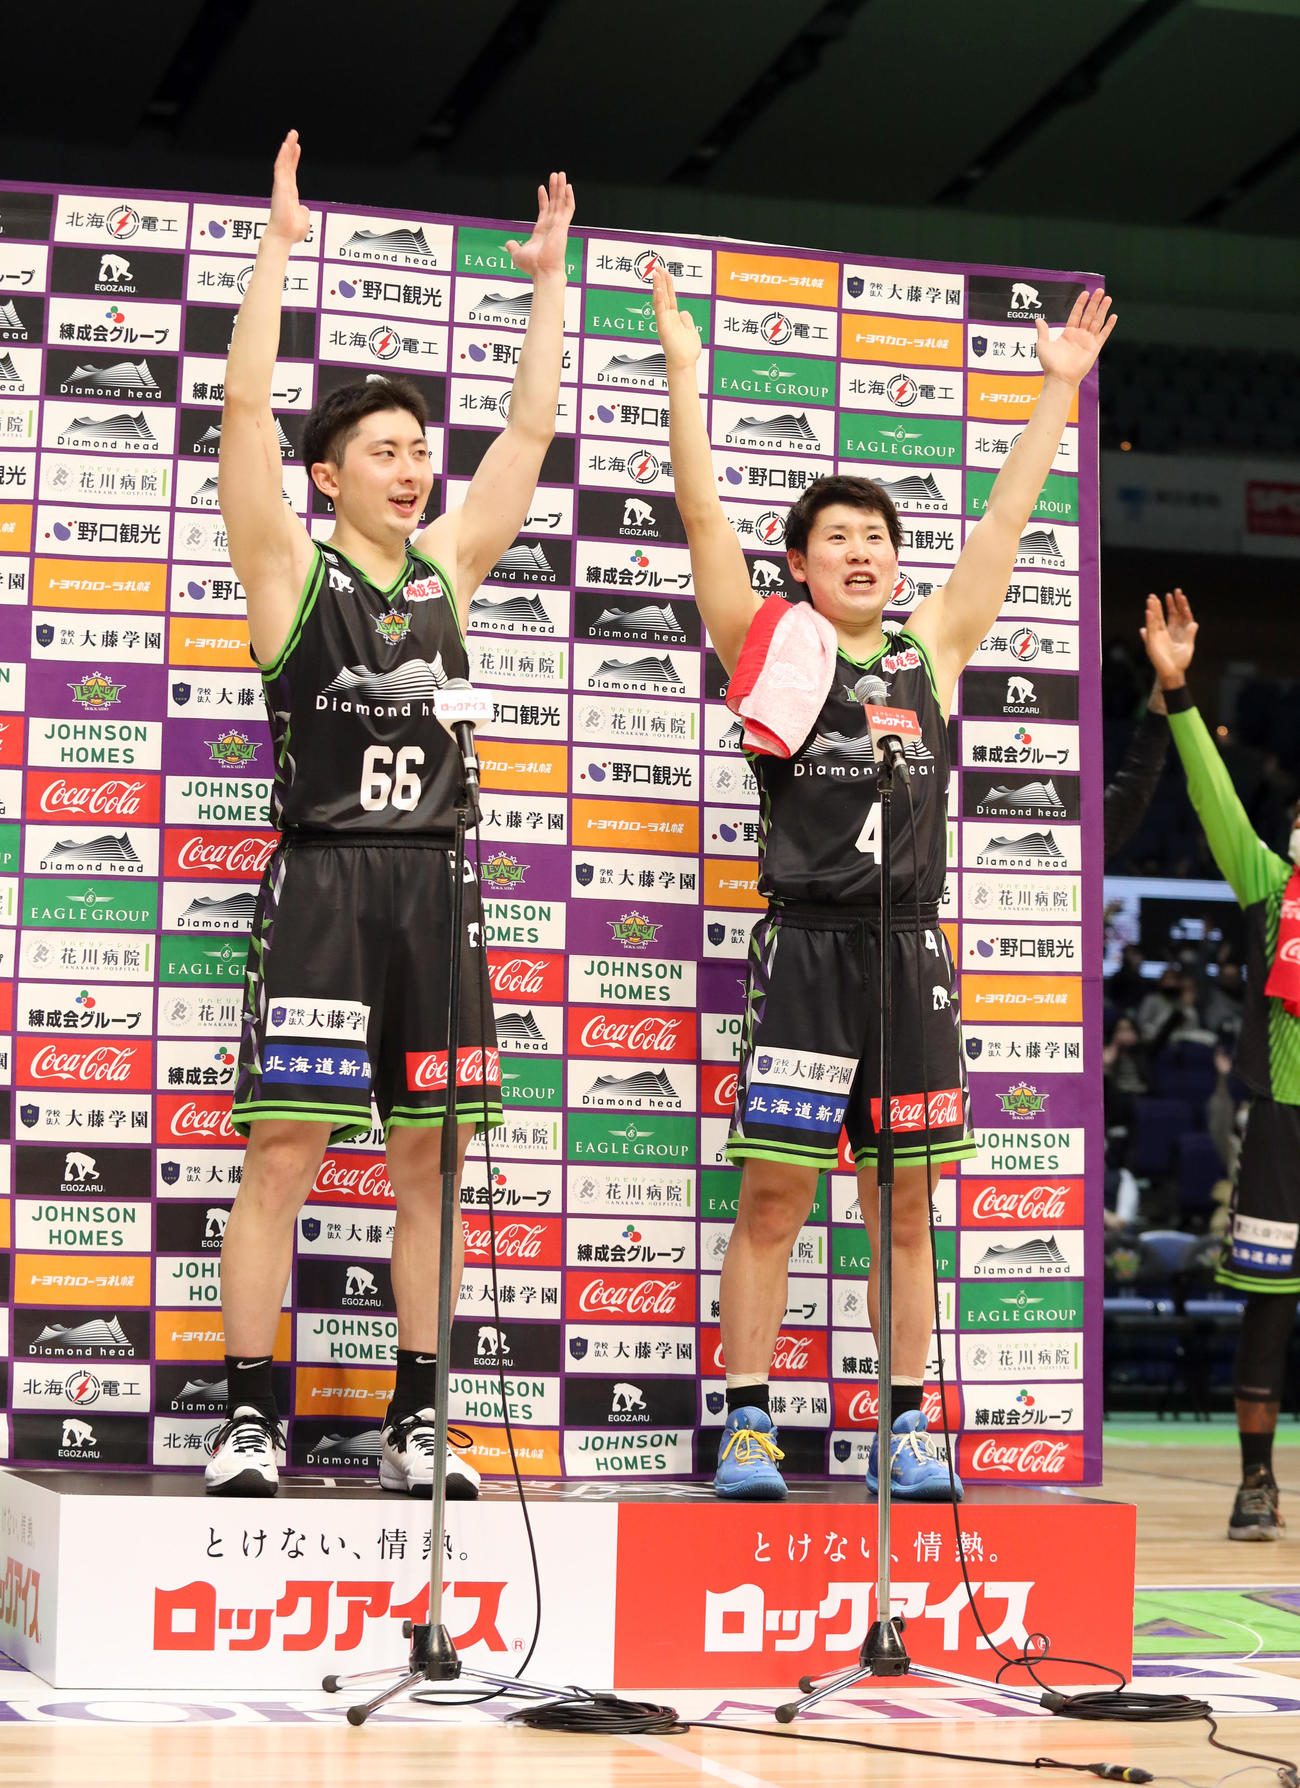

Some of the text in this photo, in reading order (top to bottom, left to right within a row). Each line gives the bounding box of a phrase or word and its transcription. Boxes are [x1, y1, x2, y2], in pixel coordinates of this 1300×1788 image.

[339, 248, 438, 268] Diamond head
[94, 284, 136, 294] EGOZARU
[730, 272, 825, 289] トヨタカローラ札幌
[362, 281, 443, 308] 野口観光
[887, 284, 961, 306] 大藤学園
[592, 316, 646, 332] EAGLE
[1007, 311, 1046, 320] EGOZARU
[59, 323, 169, 345] 練成会グループ
[856, 332, 949, 350] トヨタカローラ札幌
[60, 383, 162, 399] Diamond head
[721, 377, 829, 399] EAGLE GROUP
[57, 436, 159, 451] Diamond head
[725, 434, 821, 452] Diamond head
[847, 439, 900, 456] EAGLE
[902, 444, 956, 458] GROUP
[80, 472, 157, 491] 花川病院
[748, 467, 825, 490] 野口観光
[77, 520, 161, 545] 野口観光
[619, 527, 660, 538] EGOZARU
[48, 578, 151, 594] トヨタカローラ札幌
[585, 566, 692, 590] 練成会グループ
[1003, 584, 1072, 607] 野口観光
[60, 629, 75, 638] 学校
[60, 637, 75, 646] 法人
[79, 629, 162, 650] 大藤学園
[589, 626, 687, 644] Diamond head
[480, 654, 555, 674] 花川病院
[588, 678, 686, 695] Diamond head
[315, 694, 422, 718] Diamond
[1002, 705, 1040, 714] EGOZARU
[44, 723, 148, 742] JOHNSON
[611, 713, 686, 734] 花川病院
[60, 747, 135, 764] HOMES
[972, 744, 1070, 766] 練成会グループ
[360, 744, 425, 812] 66
[611, 762, 692, 787] 野口観光
[793, 763, 879, 778] Diamon
[40, 779, 146, 816] Coca-Cola
[485, 810, 565, 831] 大藤学園
[977, 806, 1067, 818] Diamond head
[586, 818, 684, 834] トヨタカローラ札幌
[40, 860, 144, 874] Diamond head
[977, 855, 1068, 868] Diamond head
[599, 867, 614, 876] 学校
[599, 876, 614, 884] 法人
[618, 868, 696, 891] 大藤学園
[999, 889, 1068, 907] 花川病院
[31, 907, 150, 923] EAGLE GROUP
[999, 937, 1074, 958] 野口観光
[61, 948, 140, 966] 花川病院
[168, 962, 227, 976] EAGLE
[583, 960, 683, 980] JOHNSON
[600, 983, 671, 1002] HOMES
[975, 993, 1069, 1005] トヨタカローラ札幌
[28, 1009, 142, 1030] 練成会グループ
[306, 1009, 366, 1031] 大藤学
[581, 1015, 683, 1052] Coca-Cola
[988, 1042, 1001, 1050] 学校
[988, 1049, 1001, 1057] 法人
[1005, 1041, 1080, 1060] 大藤学園
[30, 1045, 137, 1081] Coca-Cola
[789, 1059, 853, 1085] 大藤学園
[500, 1085, 556, 1100] GROUP
[582, 1095, 682, 1109] Diamond head
[45, 1109, 61, 1118] 学校
[45, 1117, 61, 1126] 法人
[65, 1109, 149, 1130] 大藤学園
[576, 1140, 689, 1158] EAGLE GROUP
[976, 1133, 1071, 1149] JOHNSON
[991, 1154, 1060, 1171] HOMES
[60, 1183, 104, 1193] EGOZARU
[606, 1183, 682, 1201] 花川病院
[459, 1187, 551, 1208] 成会グループ
[972, 1186, 1072, 1220] Coca-Cola
[32, 1206, 136, 1225] JOHNSON
[49, 1229, 124, 1247] HOMES
[576, 1244, 686, 1264] 練成会グループ
[973, 1264, 1071, 1276] Diamond head
[30, 1273, 135, 1289] トヨタカローラ札幌
[341, 1297, 383, 1308] EGOZARU
[479, 1284, 558, 1306] 大藤学園
[580, 1278, 683, 1314] Coca-Cola
[967, 1309, 1077, 1323] EAGLE GROUP
[28, 1344, 135, 1359] Diamond head
[594, 1341, 609, 1350] 学校
[594, 1349, 609, 1358] 法人
[612, 1340, 693, 1360] 大藤学園
[999, 1349, 1069, 1366] 花川病院
[449, 1378, 545, 1399] JOHNSON
[465, 1401, 533, 1421] HOMES
[608, 1413, 651, 1423] EGOZARU
[975, 1409, 1073, 1426] 練成会グループ
[578, 1433, 679, 1452] JOHNSON
[58, 1449, 101, 1460] EGOZARU
[595, 1454, 667, 1472] HOMES
[972, 1438, 1071, 1474] Coca-Cola
